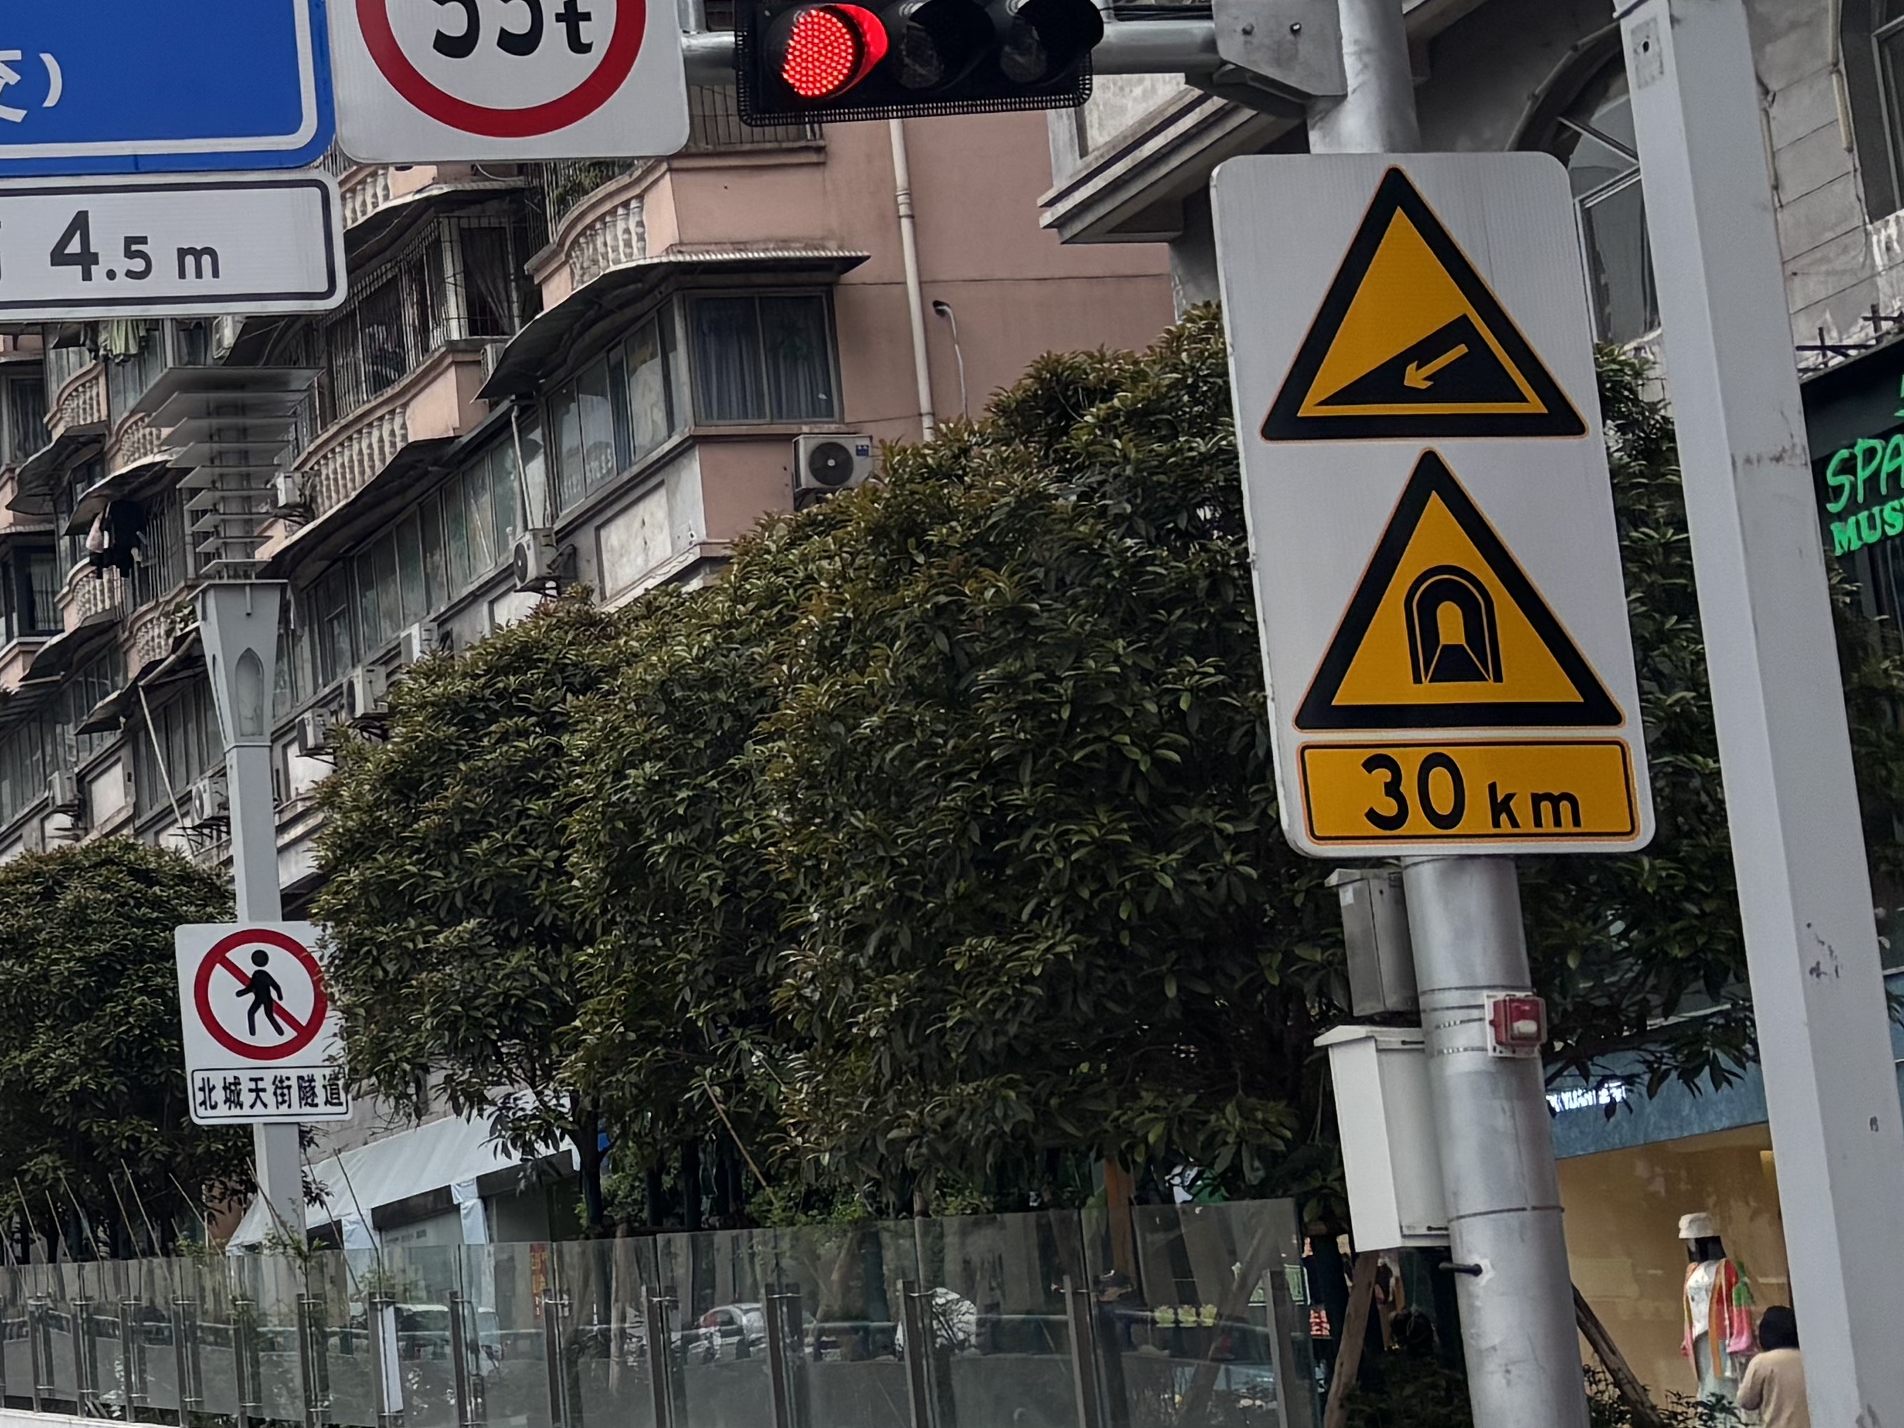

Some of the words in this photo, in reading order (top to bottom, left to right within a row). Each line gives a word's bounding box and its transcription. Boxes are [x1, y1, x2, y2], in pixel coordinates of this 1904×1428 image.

[1360, 751, 1467, 832] 30
[1487, 780, 1582, 831] km
[197, 1074, 344, 1111] 北城天街隧道
